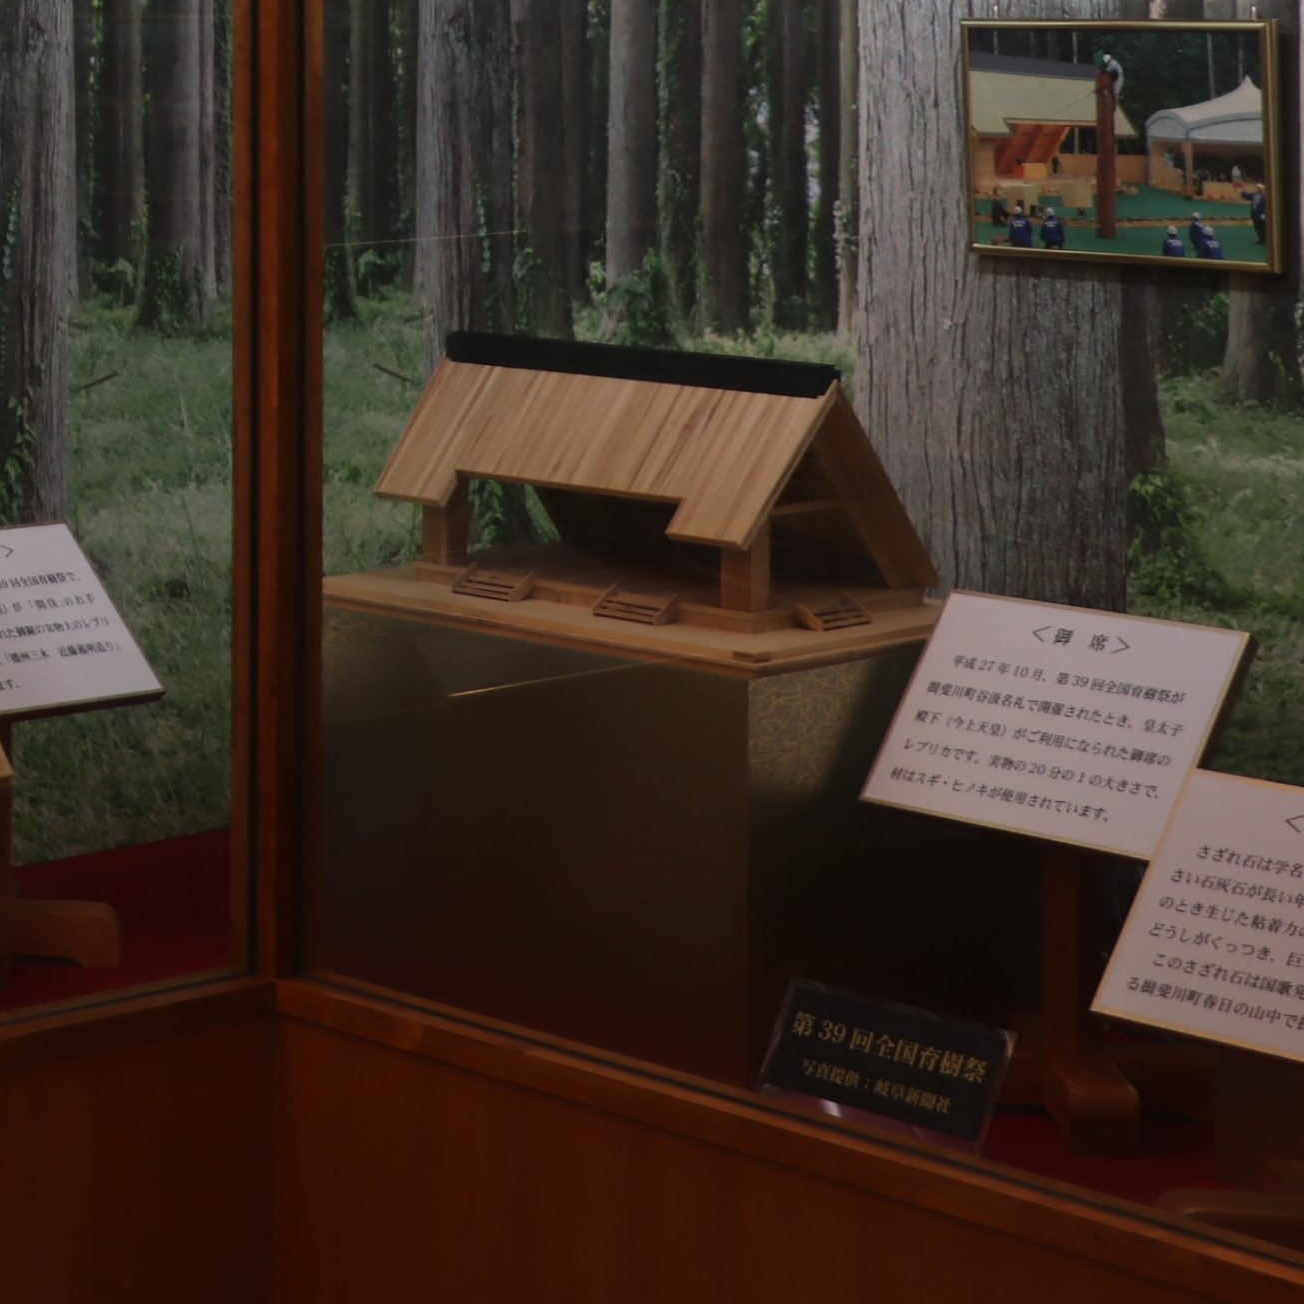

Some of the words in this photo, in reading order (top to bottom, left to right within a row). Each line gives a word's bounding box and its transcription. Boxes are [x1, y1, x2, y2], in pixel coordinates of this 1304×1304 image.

[1148, 921, 1304, 969] どうしがくっつき、巨
[791, 1010, 988, 1084] 第39回全国育樹祭
